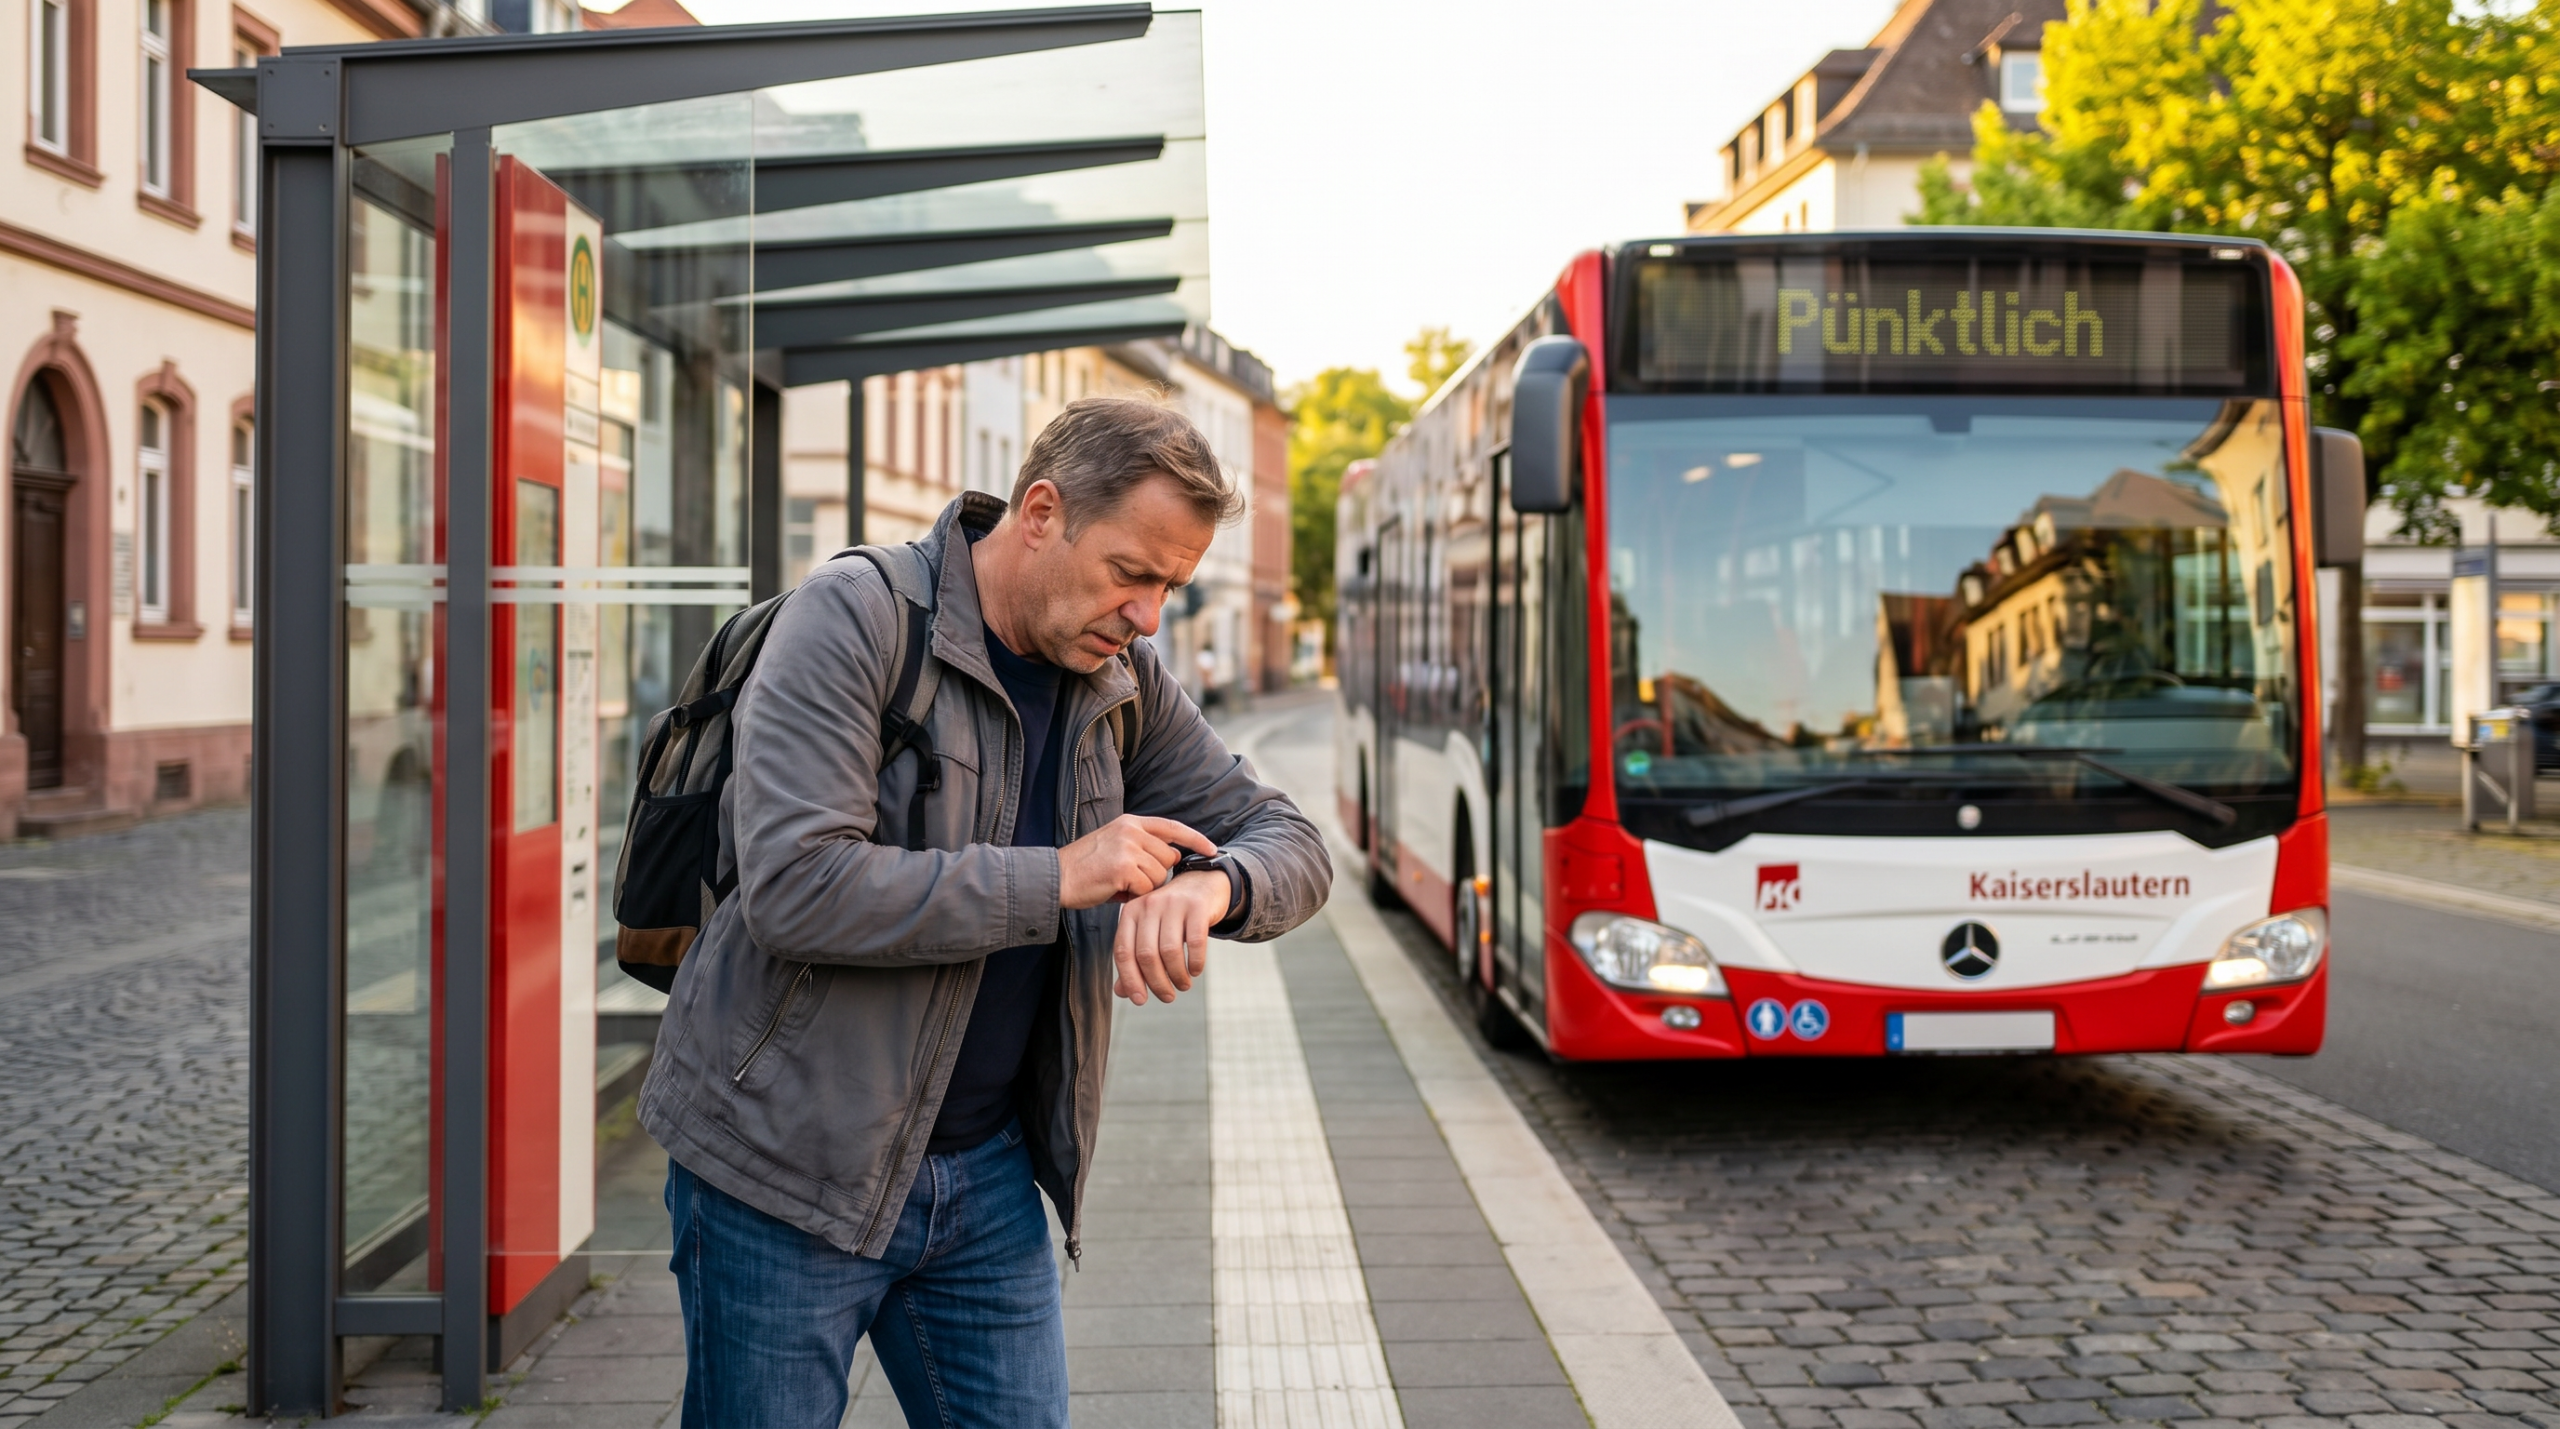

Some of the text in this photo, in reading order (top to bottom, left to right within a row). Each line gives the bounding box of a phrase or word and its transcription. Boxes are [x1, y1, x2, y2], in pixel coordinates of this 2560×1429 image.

[576, 256, 590, 325] H
[1777, 288, 2104, 358] Pünktlich
[1969, 868, 2191, 901] Kaiserslautern
